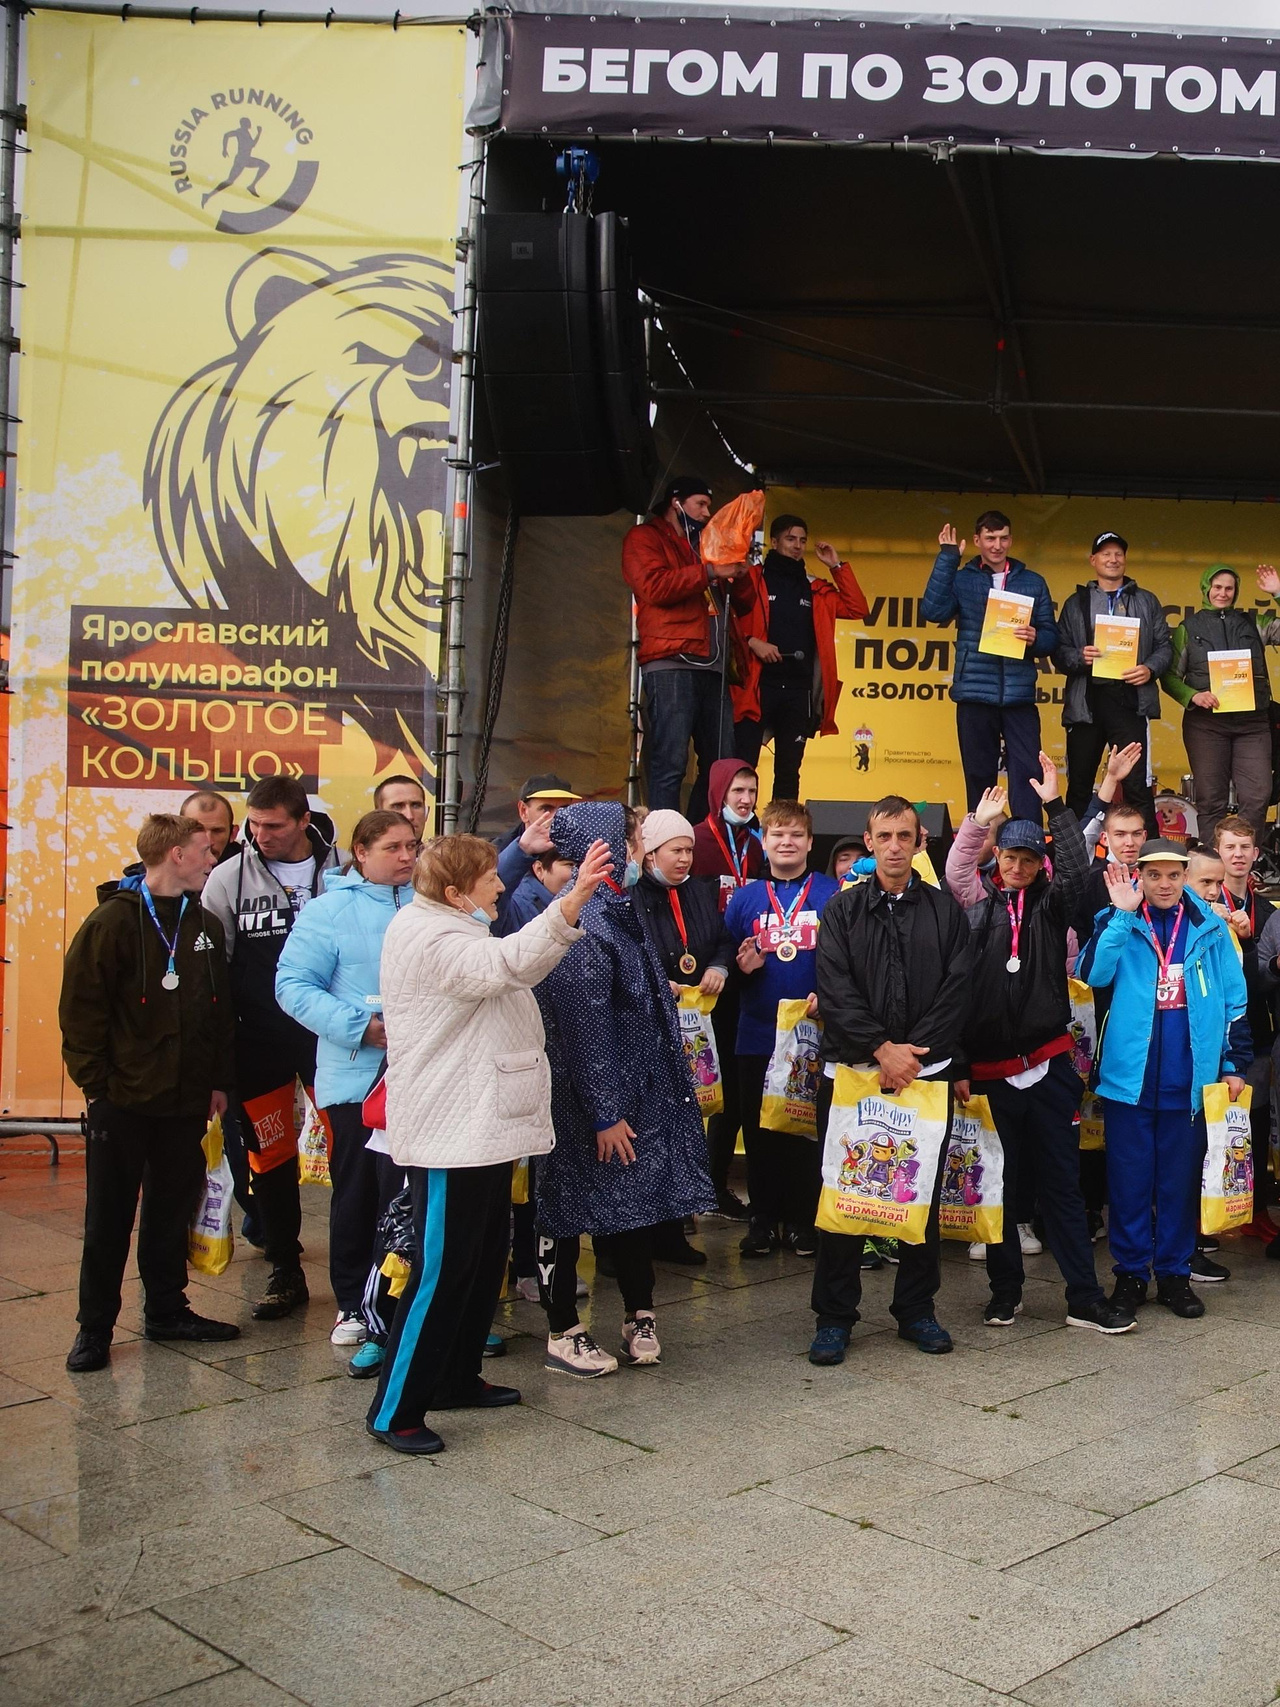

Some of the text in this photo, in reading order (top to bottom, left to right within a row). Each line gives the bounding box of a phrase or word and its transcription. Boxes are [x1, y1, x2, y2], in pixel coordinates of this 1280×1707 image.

[541, 47, 779, 98] БЕГОМ
[801, 52, 904, 102] ПО
[169, 87, 315, 194] RUSSIA RUNNING
[81, 614, 328, 647] Ярославский
[81, 659, 338, 693] полумарафон
[80, 696, 327, 736] «ЗОЛОТОЕ
[82, 745, 304, 789] КОЛЬЦО»
[247, 930, 271, 938] CHOOSE
[864, 1097, 915, 1127] фру-фру
[259, 1131, 285, 1149] BISON
[835, 1202, 909, 1222] мармелад!
